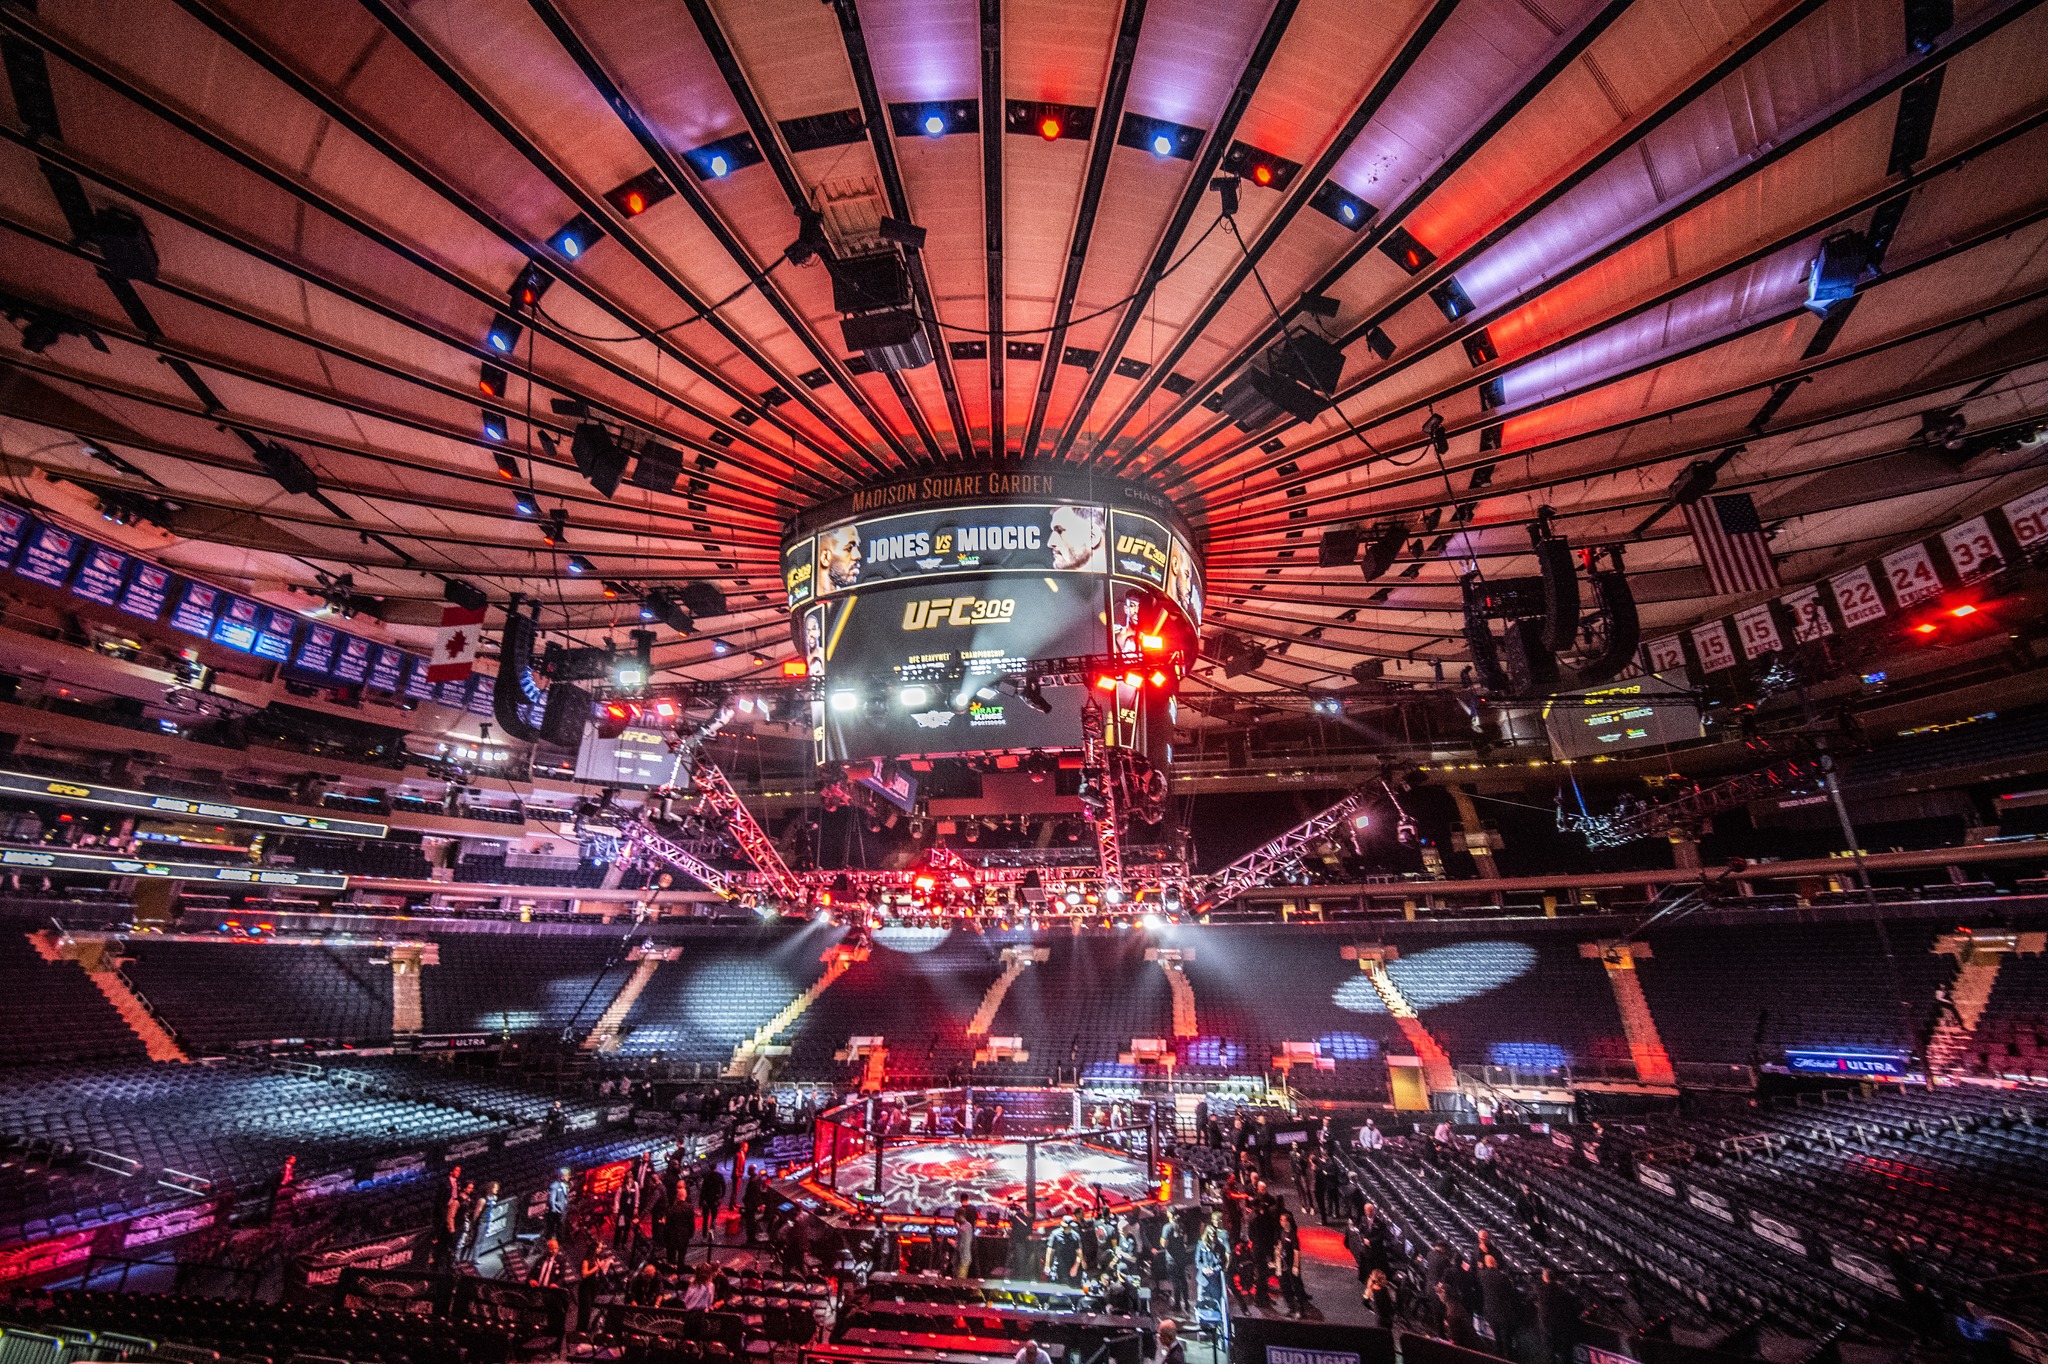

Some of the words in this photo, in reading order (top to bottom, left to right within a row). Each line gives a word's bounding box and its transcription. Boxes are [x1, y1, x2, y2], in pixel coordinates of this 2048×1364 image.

[852, 482, 917, 513] MADISON
[922, 476, 983, 499] SQUARE
[989, 472, 1053, 494] GARDEN
[1125, 488, 1164, 507] CHASE
[866, 532, 930, 563] JONES
[935, 535, 952, 550] VS
[957, 525, 1041, 551] MIOCIC
[1117, 535, 1156, 560] UFC
[1953, 535, 1994, 566] 33
[1892, 560, 1933, 591] 24
[1839, 583, 1876, 610] 22
[902, 596, 976, 630] UFC
[971, 599, 1015, 619] 309
[1744, 620, 1771, 643] 15
[1701, 635, 1724, 658] 15
[1657, 650, 1680, 670] 12
[970, 707, 1004, 716] DRAFT
[456, 1039, 485, 1047] ULTRA
[1846, 1060, 1898, 1072] ULTRA
[1271, 1350, 1306, 1364] BUD
